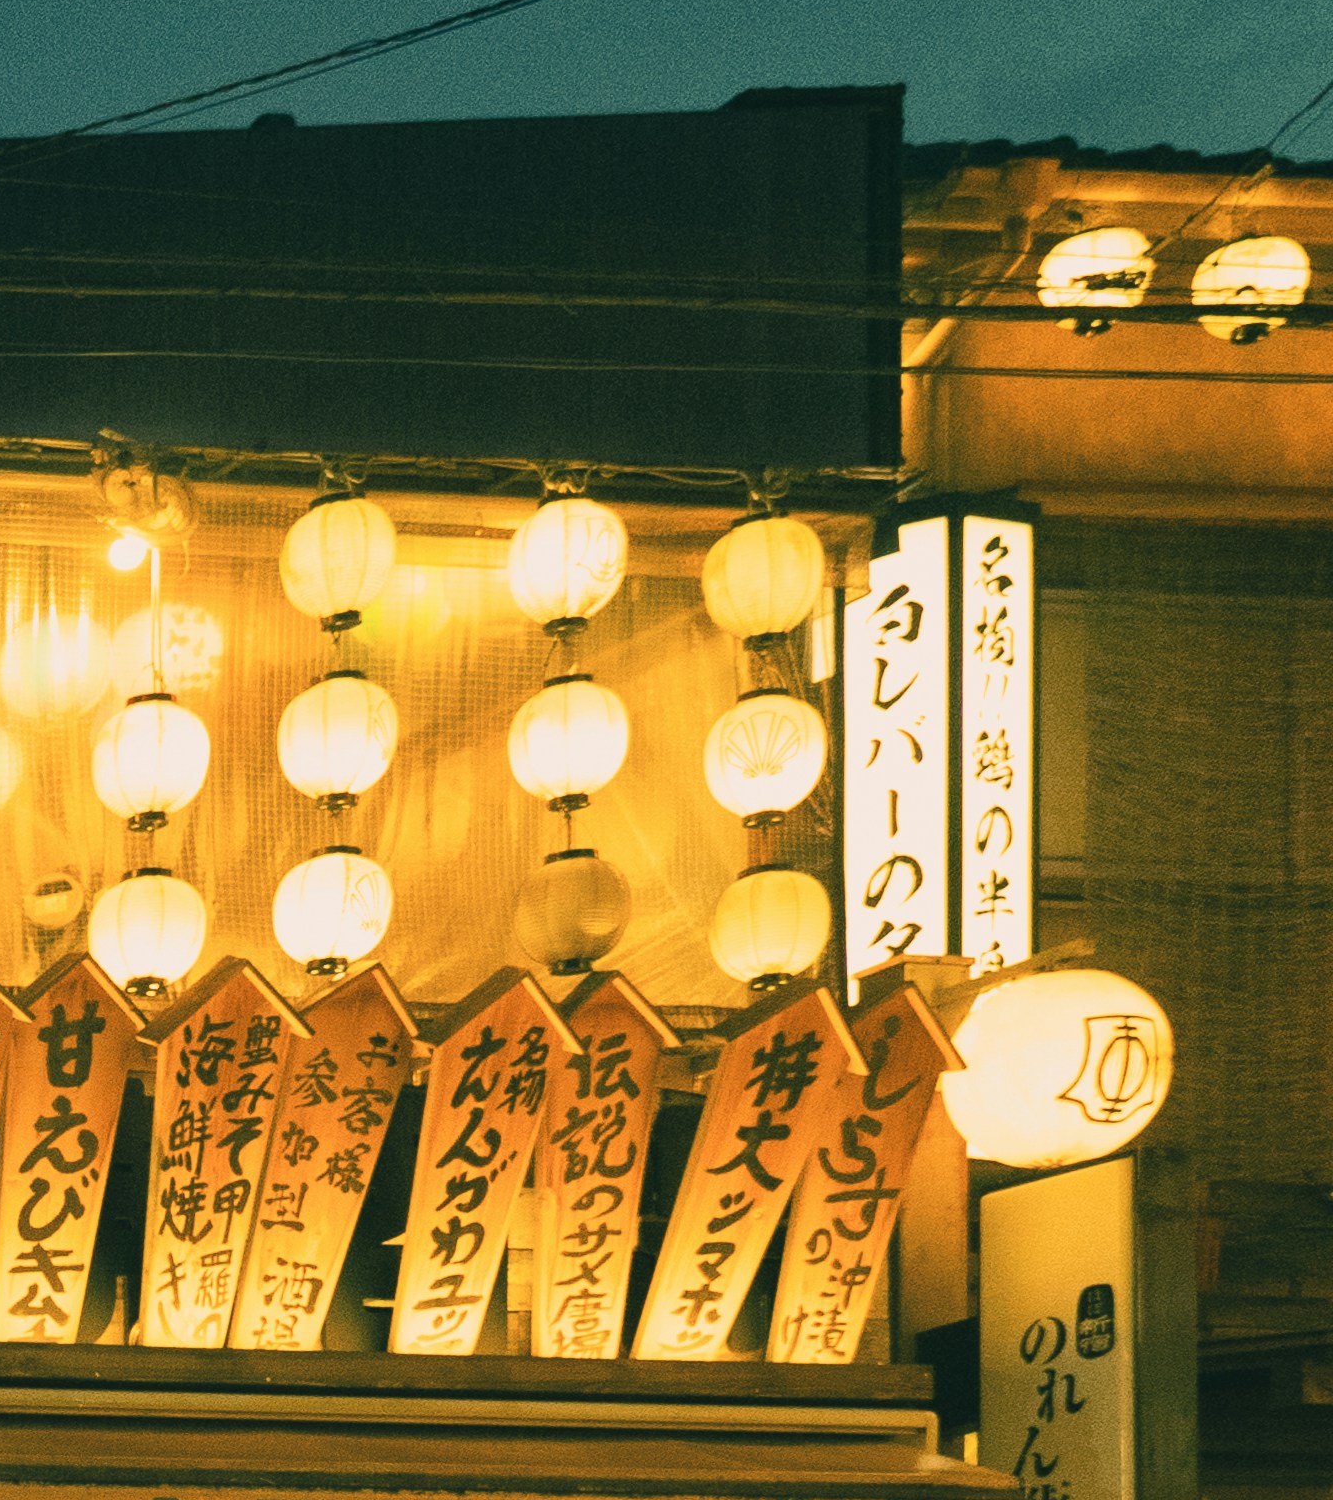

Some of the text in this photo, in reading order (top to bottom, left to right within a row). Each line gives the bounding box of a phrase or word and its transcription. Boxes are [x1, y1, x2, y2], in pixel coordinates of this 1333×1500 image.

[316, 1032, 399, 1194] お客様
[496, 1026, 550, 1116] 名物
[409, 1025, 518, 1348] えんがわユッ
